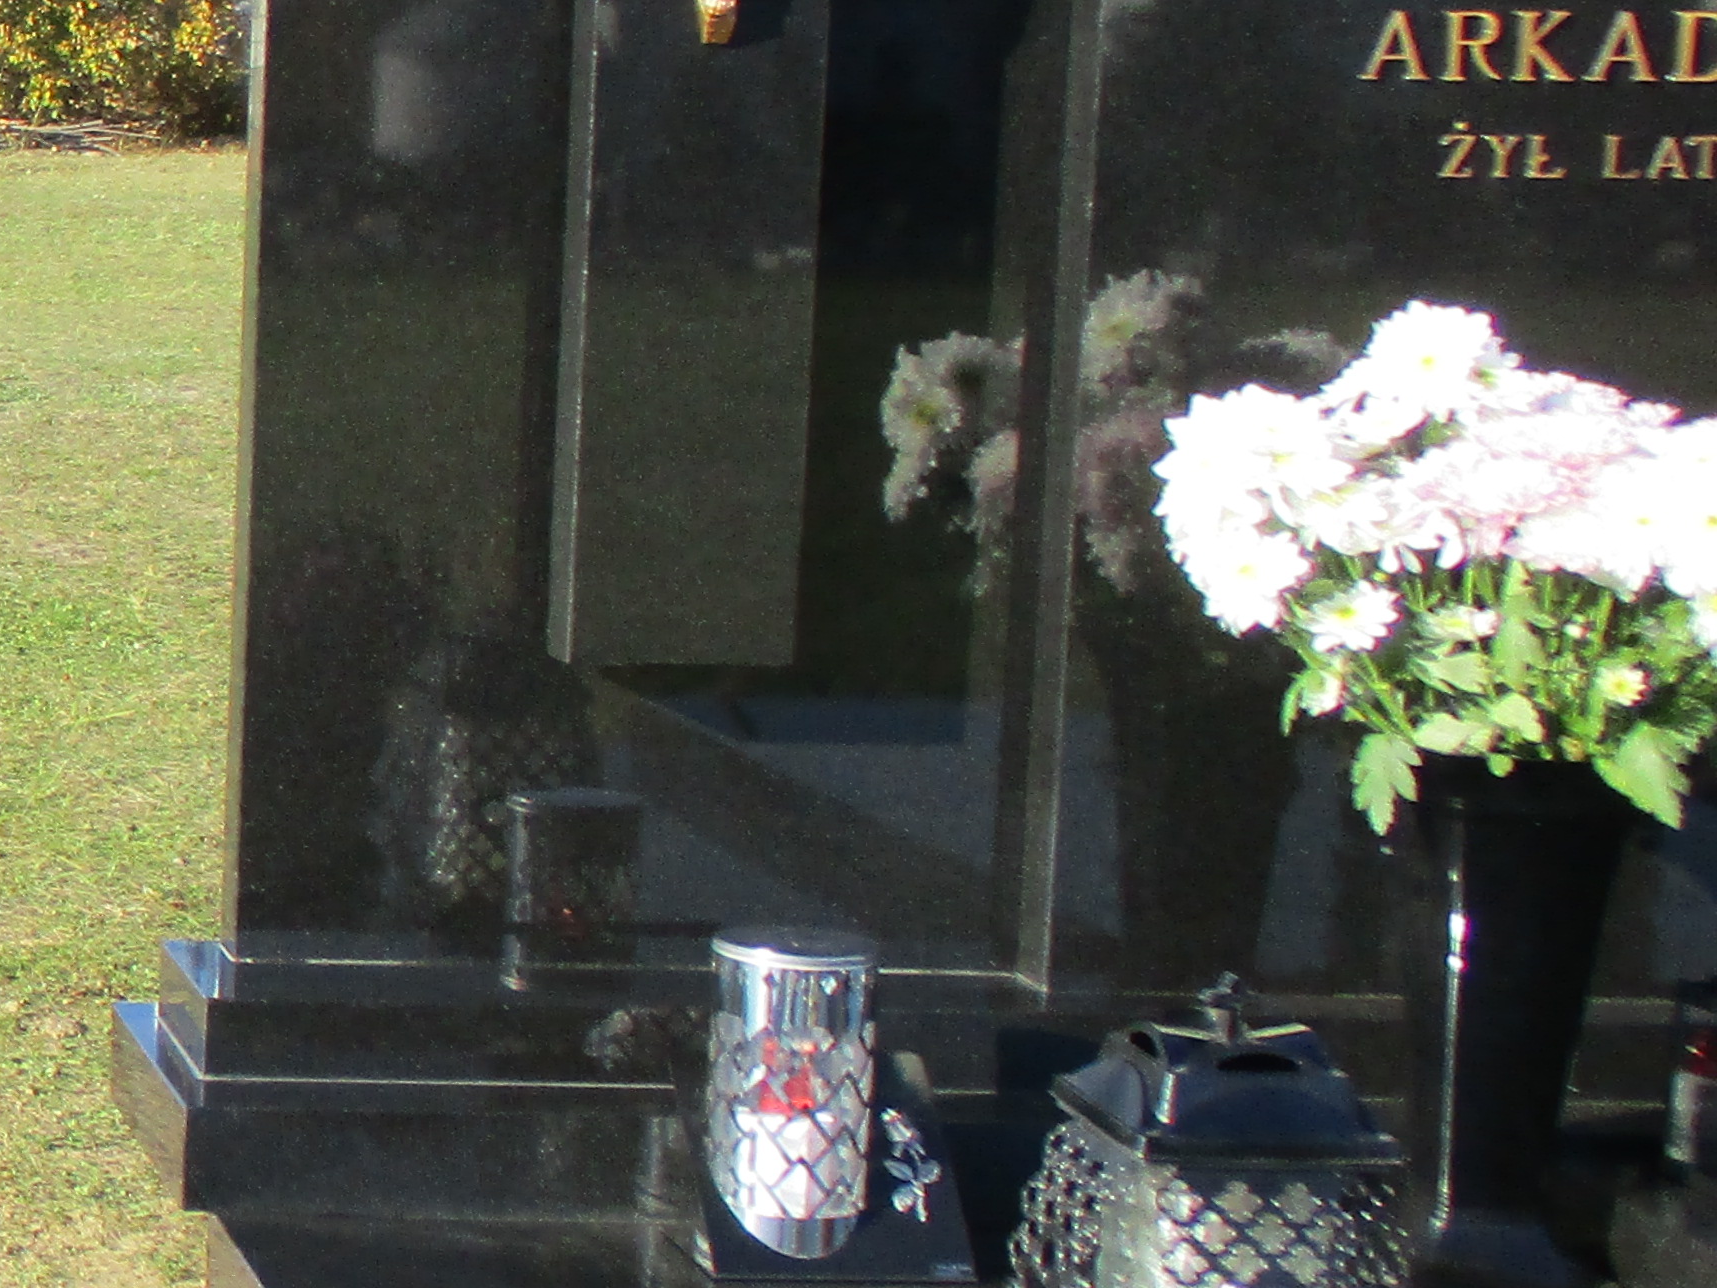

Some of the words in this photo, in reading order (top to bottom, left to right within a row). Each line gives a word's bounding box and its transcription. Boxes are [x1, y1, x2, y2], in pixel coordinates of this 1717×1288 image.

[1355, 9, 1717, 82] ARKAD
[1435, 120, 1568, 180] ŻYŁ
[1599, 133, 1717, 180] LAT
